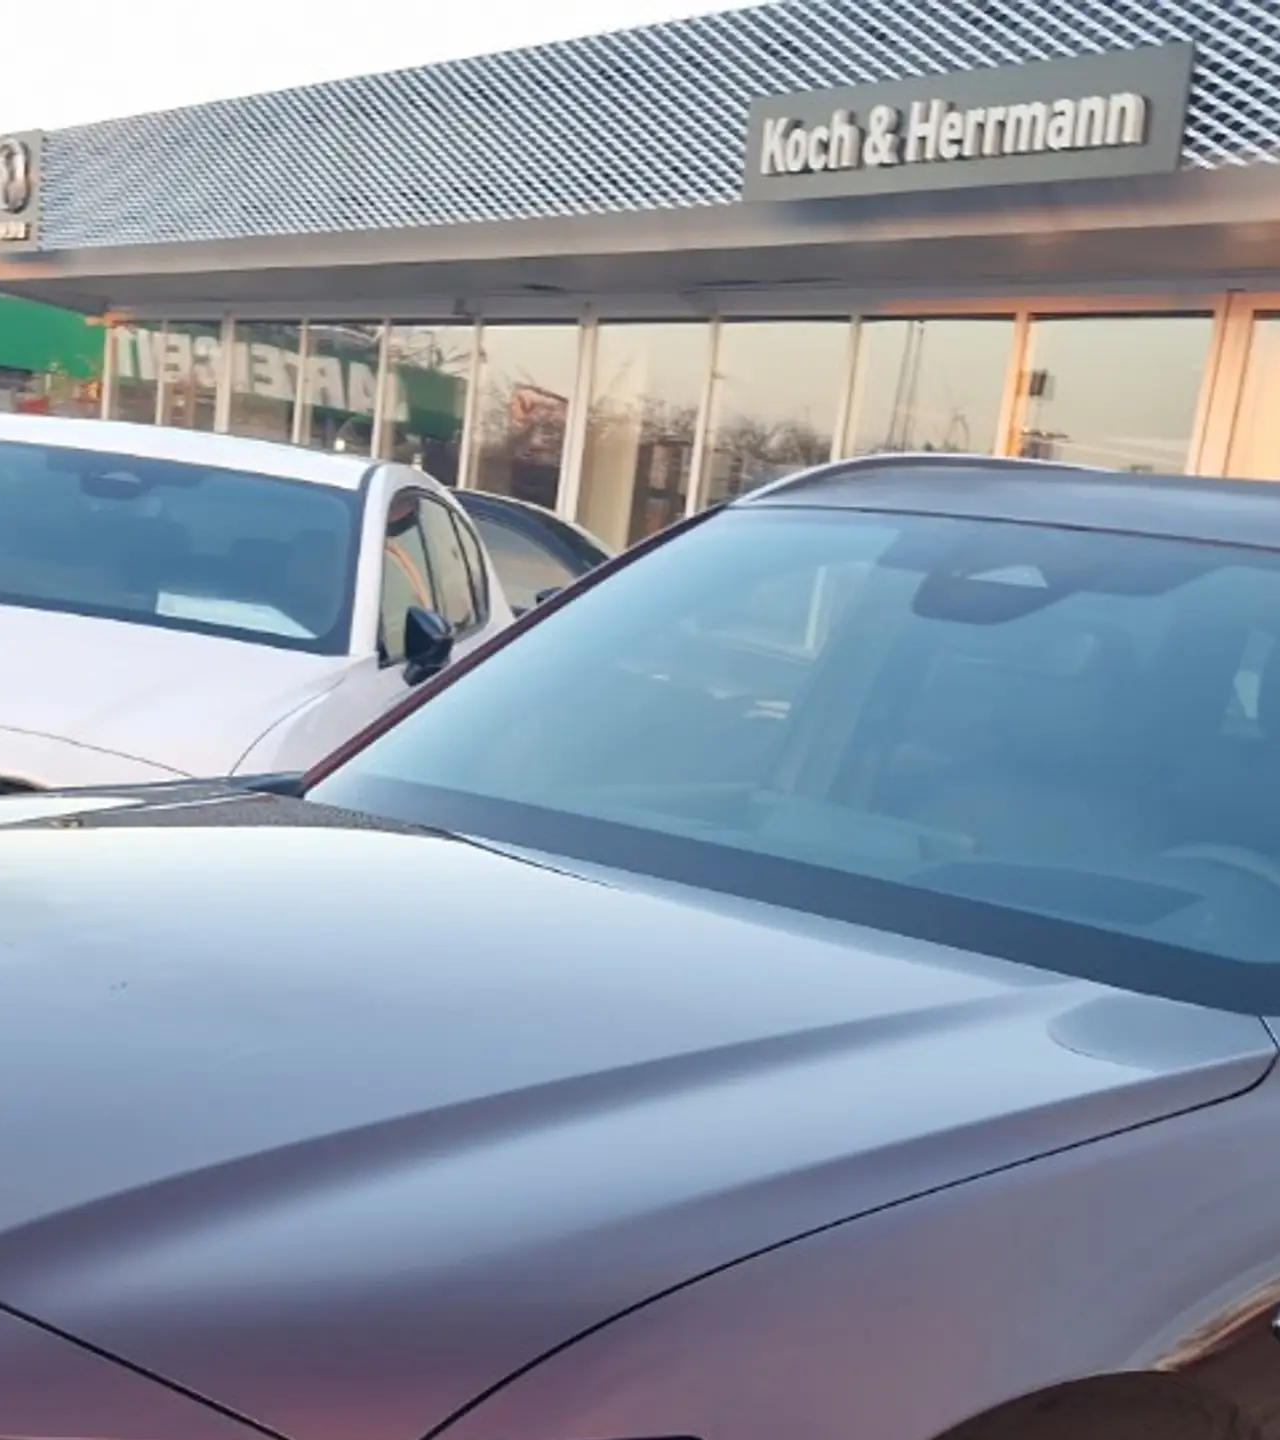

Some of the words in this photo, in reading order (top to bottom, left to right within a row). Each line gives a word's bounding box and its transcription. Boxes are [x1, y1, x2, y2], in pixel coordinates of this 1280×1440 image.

[760, 110, 858, 175] Koch
[863, 104, 900, 166] &
[905, 91, 1147, 163] Herrmann
